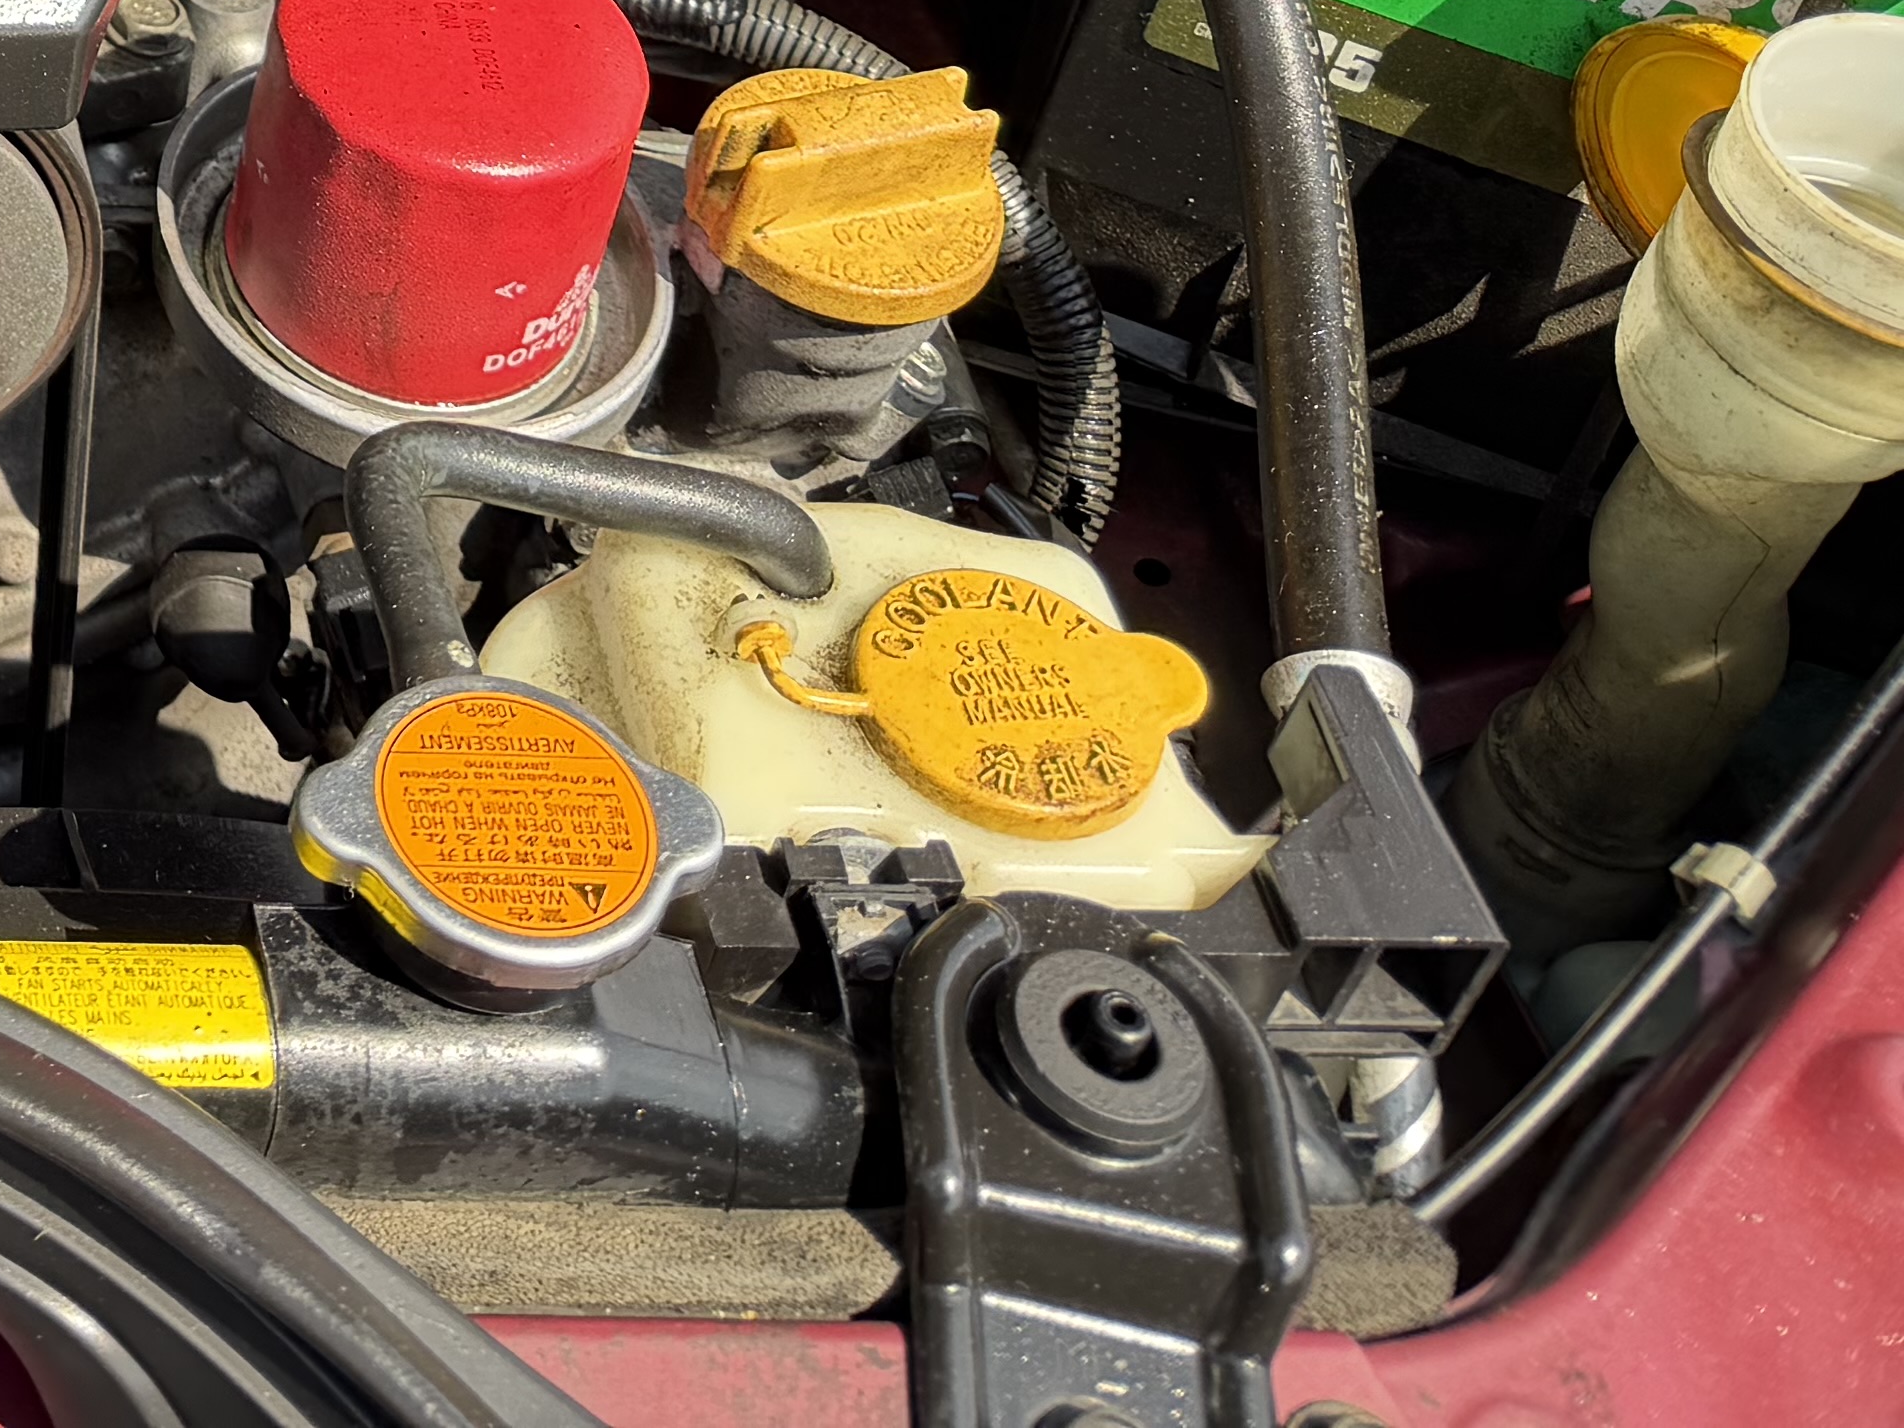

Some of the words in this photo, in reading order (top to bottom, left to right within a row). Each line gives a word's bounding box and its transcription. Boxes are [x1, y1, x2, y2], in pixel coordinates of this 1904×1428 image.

[871, 576, 1101, 661] COOLANT
[955, 639, 1026, 667] SEE
[948, 663, 1072, 699] OWNERS
[962, 691, 1090, 726] MANUAL
[419, 733, 575, 754] AVERTISSEMENT
[976, 727, 1133, 801] 冷却水
[479, 801, 538, 816] OUVRIR
[544, 802, 599, 818] JAMAIS
[605, 805, 624, 819] NE
[409, 815, 444, 830] HOT
[454, 816, 510, 831] WHEN
[515, 818, 563, 833] OPEN
[571, 820, 630, 835] NEVER
[462, 886, 568, 906] WARNING
[18, 978, 44, 990] FAN
[53, 978, 104, 992] STARTS
